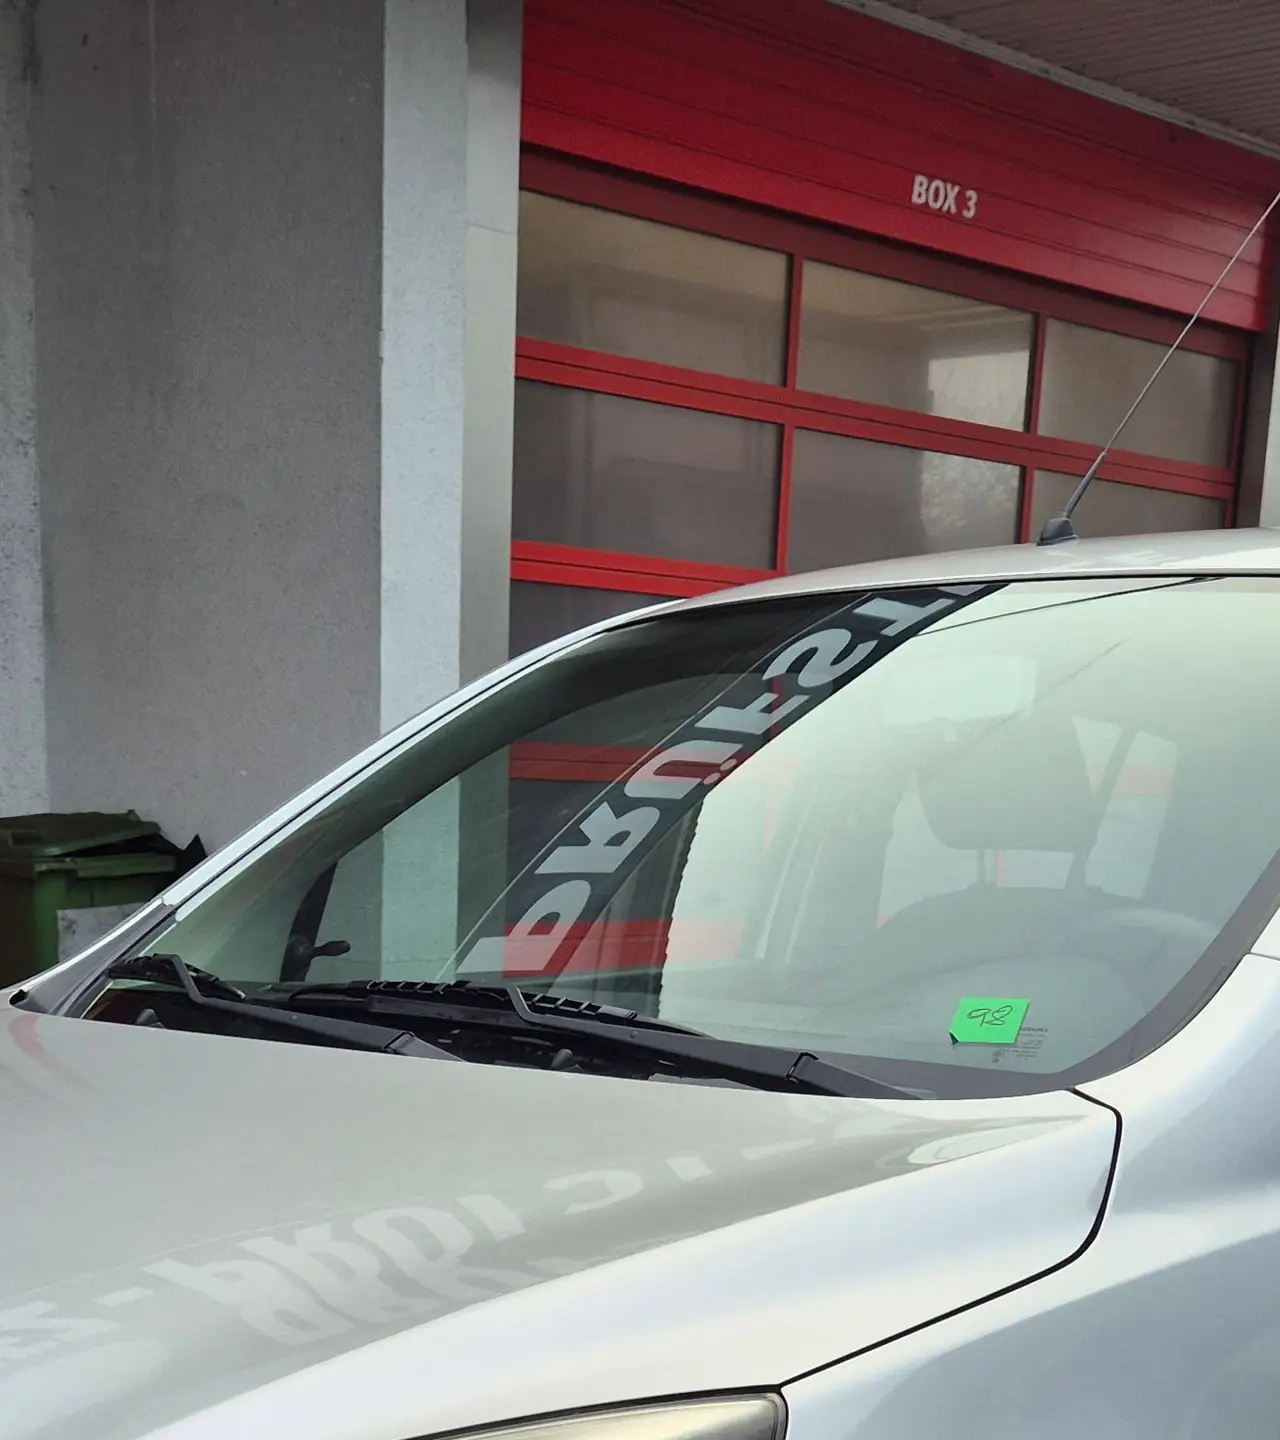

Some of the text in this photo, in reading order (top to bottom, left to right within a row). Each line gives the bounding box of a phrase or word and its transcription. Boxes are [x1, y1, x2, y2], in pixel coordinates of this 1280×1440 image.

[911, 174, 978, 218] BOX 3
[966, 1004, 1014, 1028] 98
